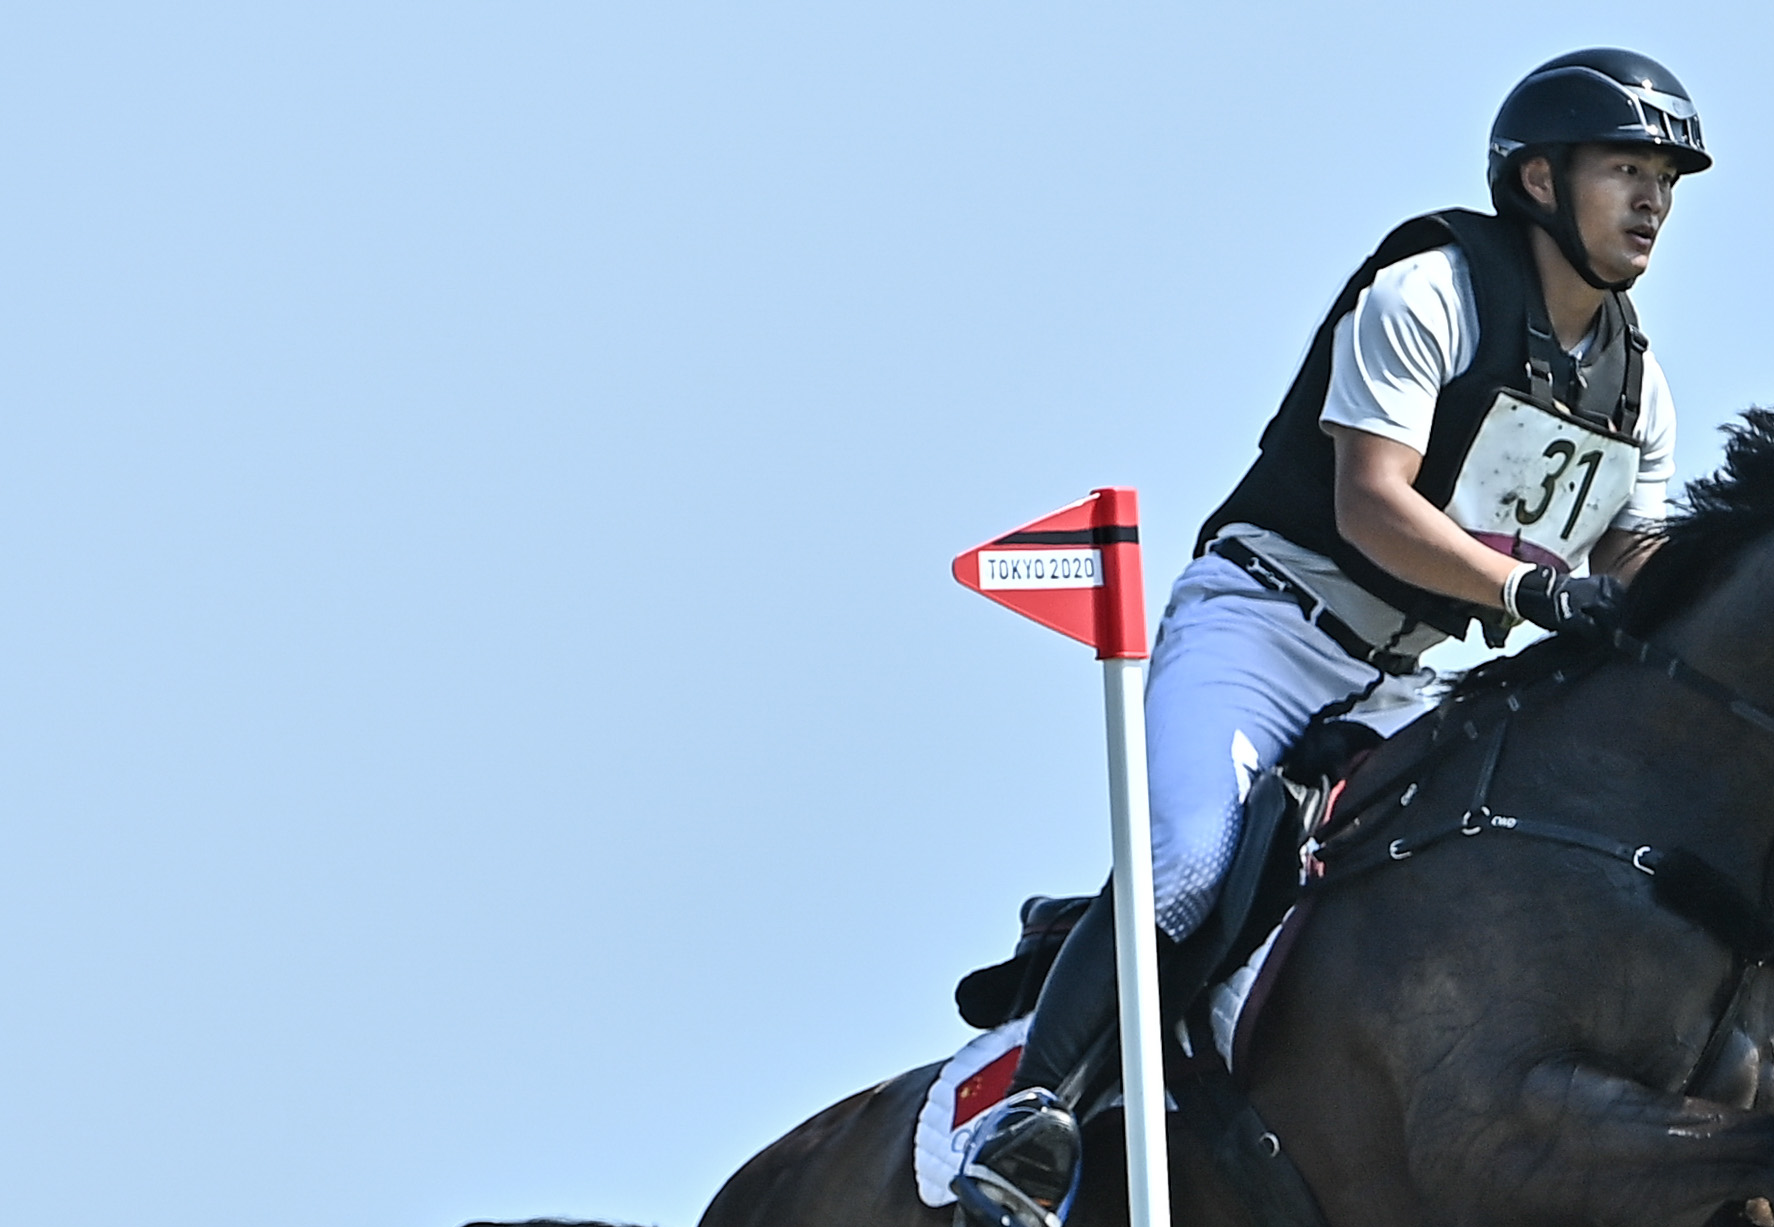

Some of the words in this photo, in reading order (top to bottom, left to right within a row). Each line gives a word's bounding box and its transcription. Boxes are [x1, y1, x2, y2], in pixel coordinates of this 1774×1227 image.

[1515, 438, 1604, 541] 31
[987, 558, 1045, 580] TOKYO
[1049, 557, 1095, 580] 2020
